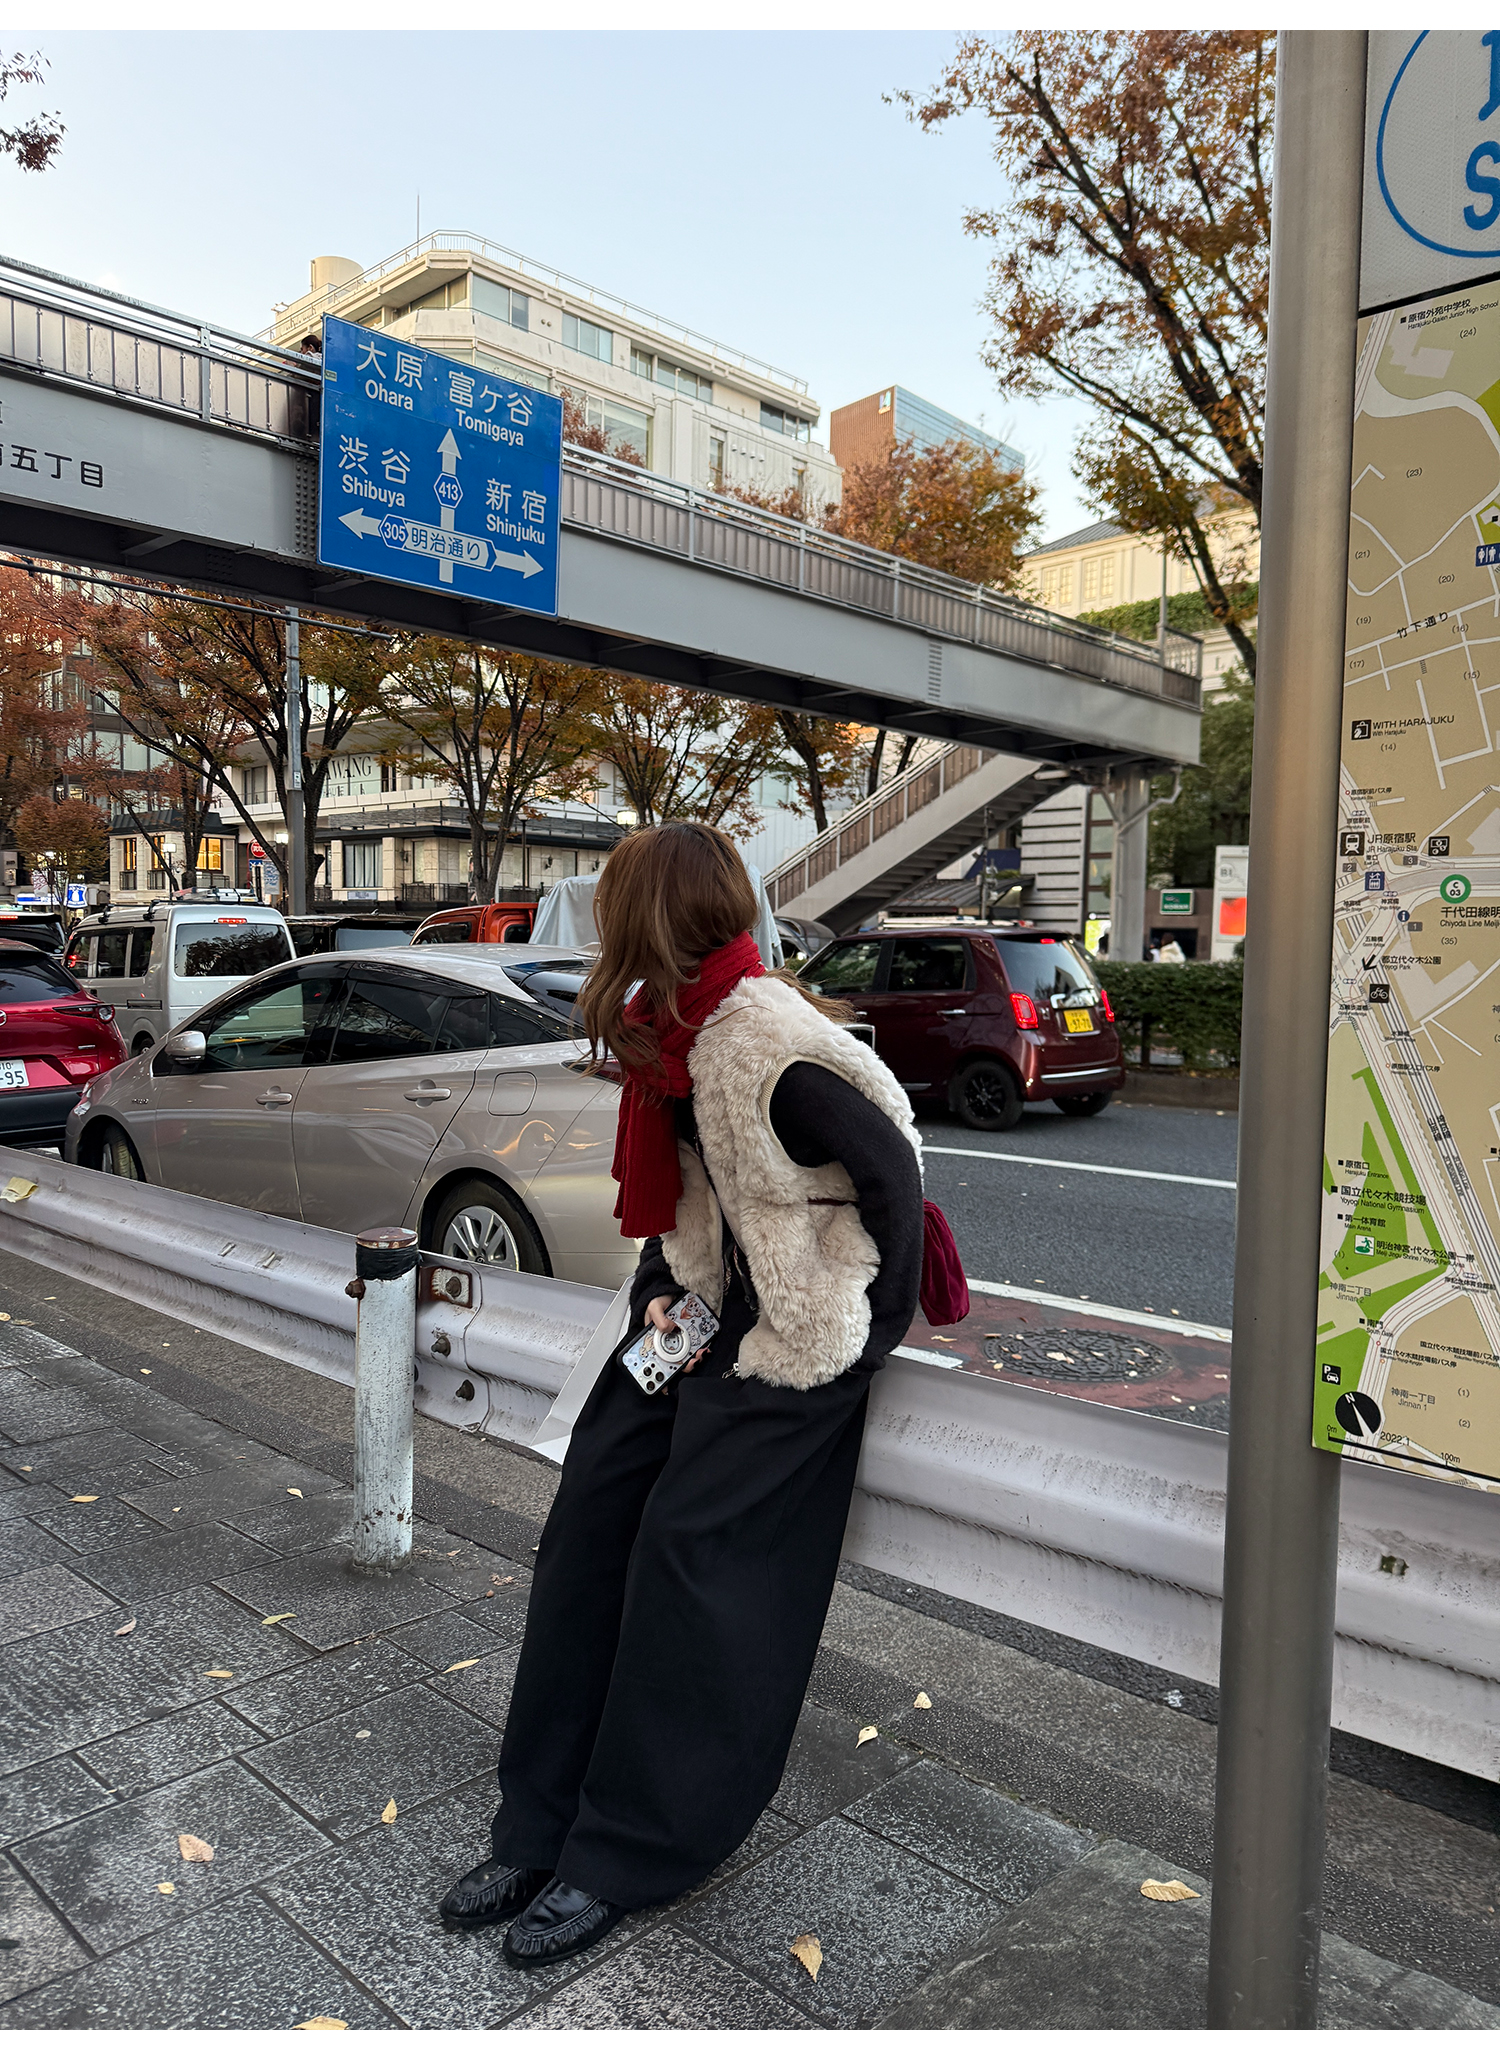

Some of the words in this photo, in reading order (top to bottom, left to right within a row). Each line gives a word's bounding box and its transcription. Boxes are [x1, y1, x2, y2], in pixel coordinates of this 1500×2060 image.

[1408, 299, 1471, 323] 原宿外苑中学校
[1466, 306, 1479, 314] High
[1480, 300, 1499, 310] School
[1460, 327, 1477, 339] (24)
[365, 378, 414, 412] Ohara
[455, 408, 524, 447] Tomigaya
[0, 443, 103, 488] 五丁目
[338, 434, 411, 485] 渋谷
[1406, 467, 1423, 478] (23)
[342, 474, 406, 508] Shibuya
[438, 480, 459, 501] 413
[486, 477, 547, 524] 新宿
[384, 521, 406, 542] 305
[486, 514, 546, 545] Shinjuku
[411, 528, 481, 561] 明治通り
[1355, 549, 1371, 560] (21)
[1438, 573, 1455, 584] (20)
[1356, 616, 1372, 626] (19)
[1397, 611, 1449, 639] 竹下通り
[1452, 624, 1469, 634] (16)
[1349, 660, 1365, 669] (17)
[1463, 670, 1481, 680] (15)
[1373, 720, 1396, 730] WITH
[1399, 715, 1455, 728] HARAJUKU
[1381, 743, 1397, 752] (14)
[331, 756, 372, 779] WANG
[1367, 832, 1416, 844] JR原宿駅
[1440, 919, 1467, 928] Chiyoda
[1468, 919, 1482, 927] Line
[1441, 936, 1458, 945] (35)
[1381, 956, 1441, 965] 都立代々木公園
[0, 1062, 12, 1070] 10
[1345, 1160, 1370, 1170] 原宿口
[1341, 1185, 1426, 1206] 国立代々木競技場
[1340, 1196, 1360, 1207] Yoyogi
[1360, 1197, 1386, 1210] National
[1388, 1202, 1425, 1215] Gymnasium
[1345, 1214, 1386, 1228] 第一体育館
[1356, 1224, 1371, 1232] Arena
[1334, 1250, 1345, 1259] (1)
[1330, 1282, 1372, 1297] 神南二丁目
[1336, 1293, 1358, 1303] Jinnan
[1324, 1366, 1331, 1374] P
[1345, 1392, 1355, 1404] N
[1391, 1387, 1436, 1405] 神南一丁目
[1458, 1388, 1470, 1397] (1)
[1398, 1398, 1422, 1410] Jinnan
[1326, 1424, 1337, 1433] 0m
[1458, 1419, 1471, 1429] (2)
[1440, 1452, 1461, 1463] 100m
